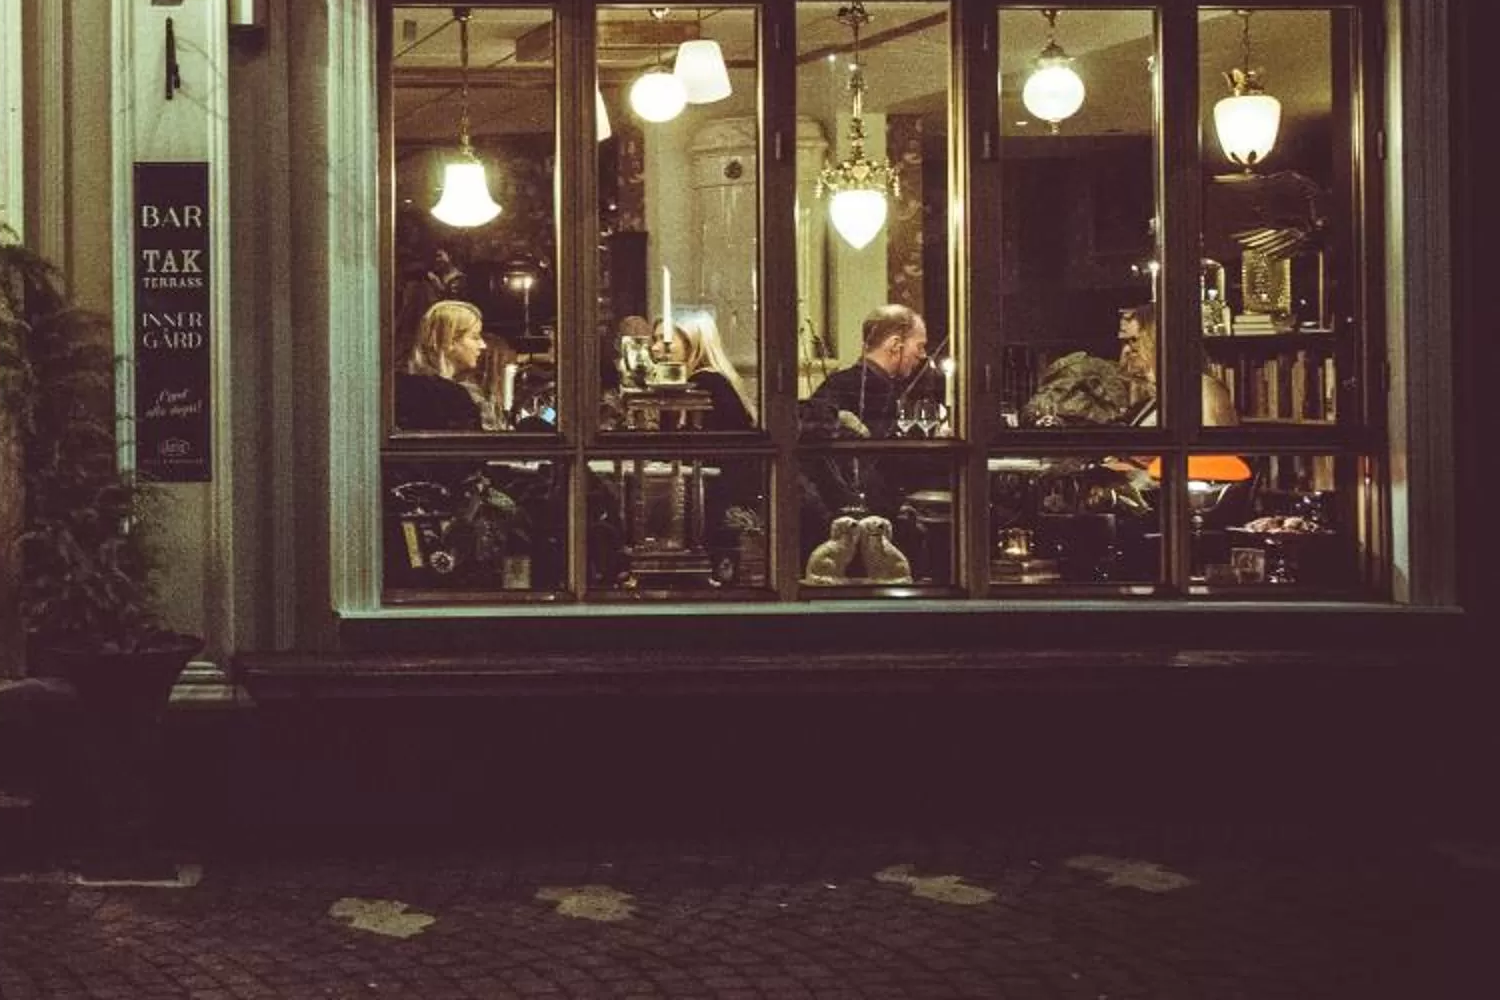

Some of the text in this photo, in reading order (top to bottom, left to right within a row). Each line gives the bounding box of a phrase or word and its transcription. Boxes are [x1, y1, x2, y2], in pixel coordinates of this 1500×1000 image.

[141, 204, 203, 228] BAR
[142, 249, 203, 273] TAK
[143, 276, 203, 290] TERRASS
[142, 311, 203, 328] INNER
[142, 327, 203, 350] GÅRD
